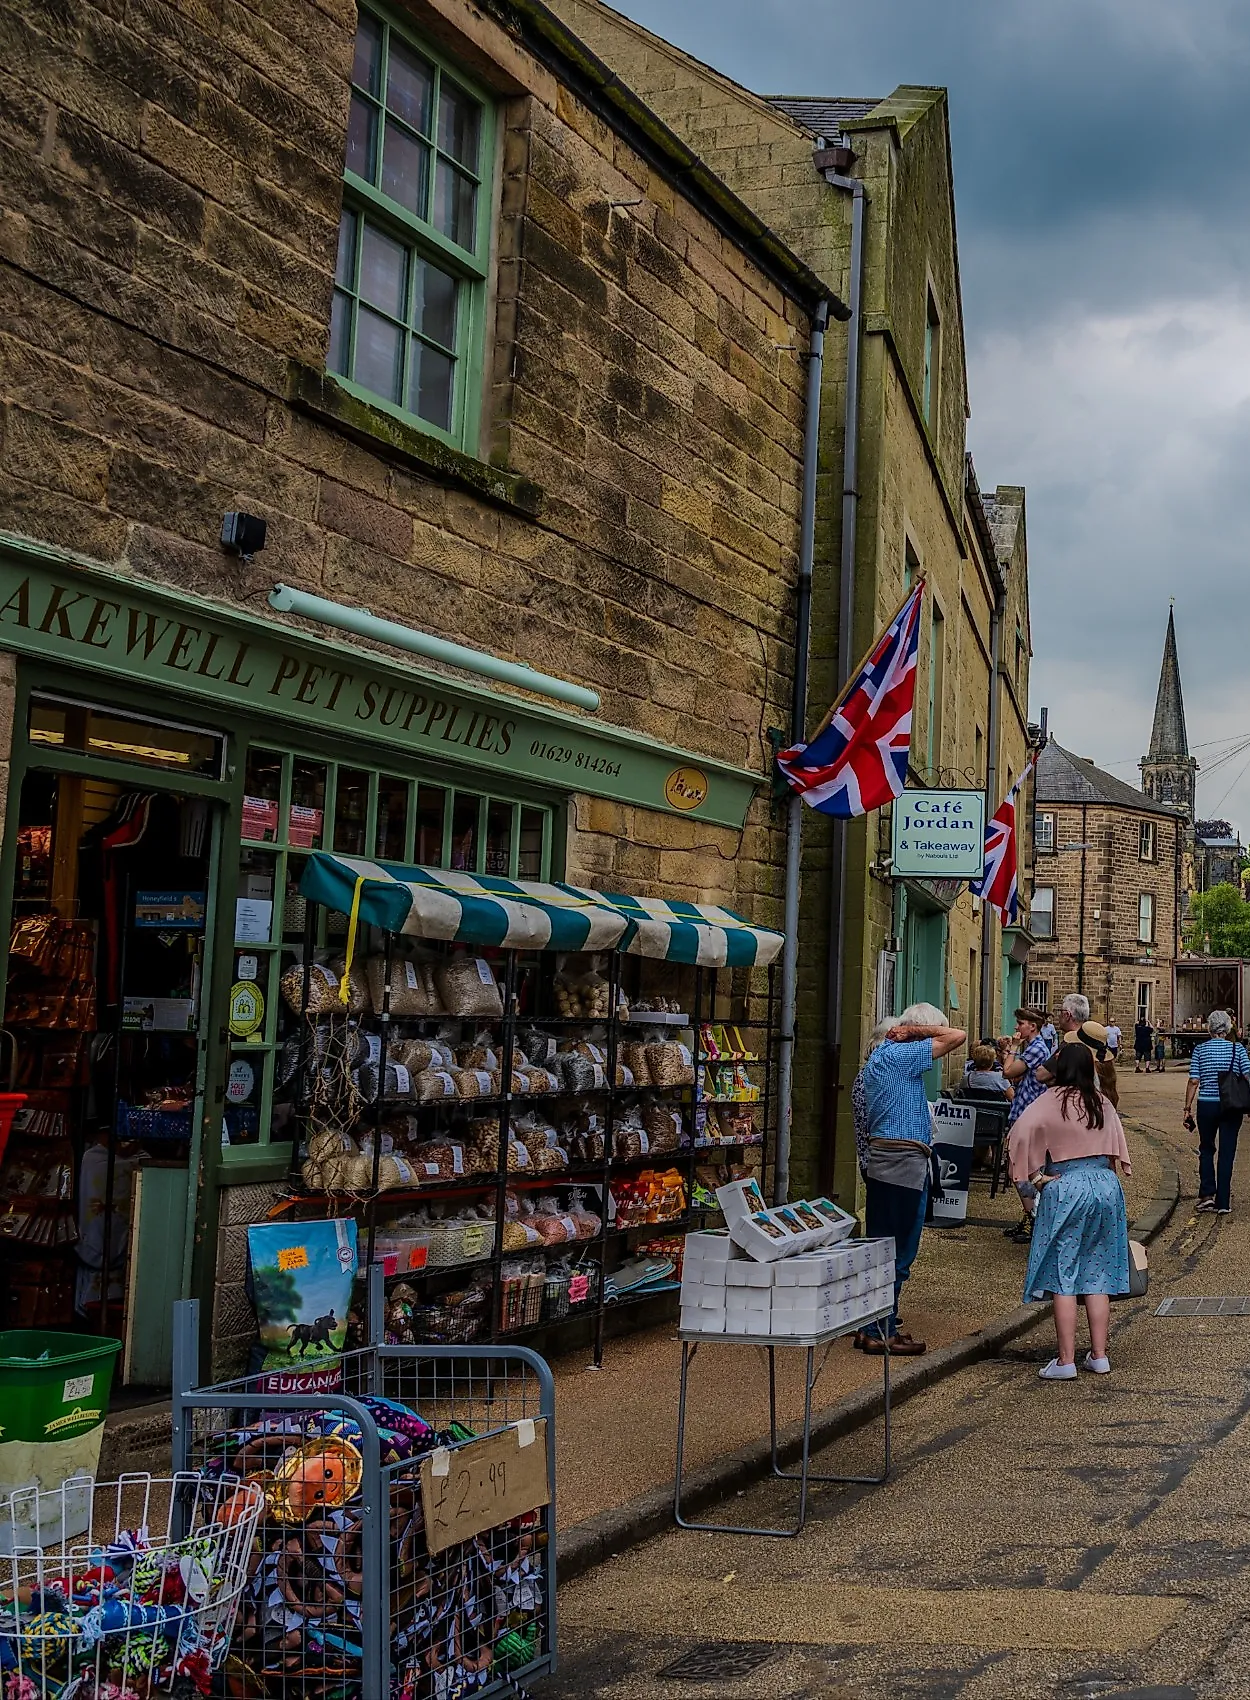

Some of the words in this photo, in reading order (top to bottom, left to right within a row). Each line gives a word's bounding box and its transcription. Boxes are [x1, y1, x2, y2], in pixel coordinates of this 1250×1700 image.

[267, 654, 353, 711] PET
[354, 679, 518, 756] SUPPLIES
[530, 740, 574, 765] 01629
[574, 752, 622, 779] 814264
[914, 800, 963, 814] Café
[902, 816, 975, 831] Jordan
[899, 840, 909, 850] &
[913, 840, 976, 852] Takeaway
[230, 1082, 246, 1090] SOLD
[434, 1461, 507, 1528] £2.99
